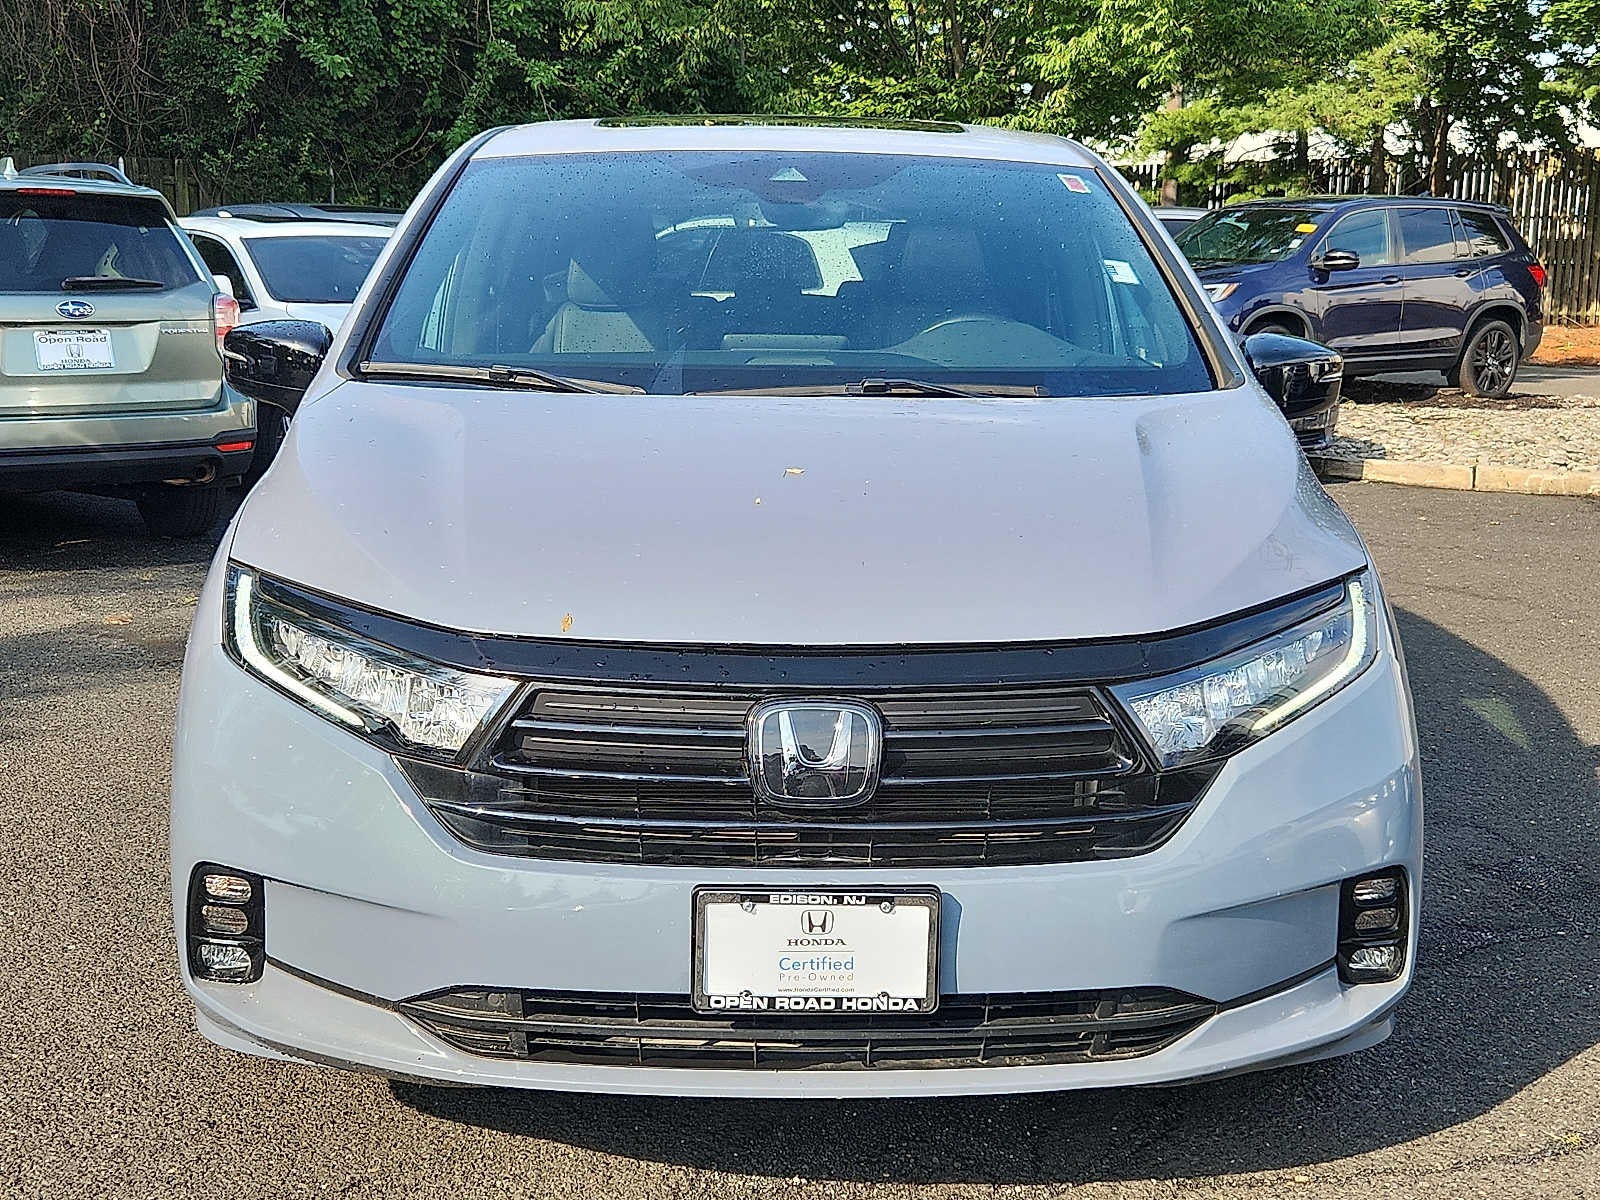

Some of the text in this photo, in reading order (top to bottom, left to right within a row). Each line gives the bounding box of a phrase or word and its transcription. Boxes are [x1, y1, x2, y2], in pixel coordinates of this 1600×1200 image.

[38, 335, 107, 344] Open Road
[769, 894, 867, 905] EDISON, NJ
[786, 938, 847, 947] HONDA
[779, 955, 855, 971] Certified
[779, 972, 855, 982] Pre-Owned
[709, 995, 919, 1011] OPEN ROAD HONDA
